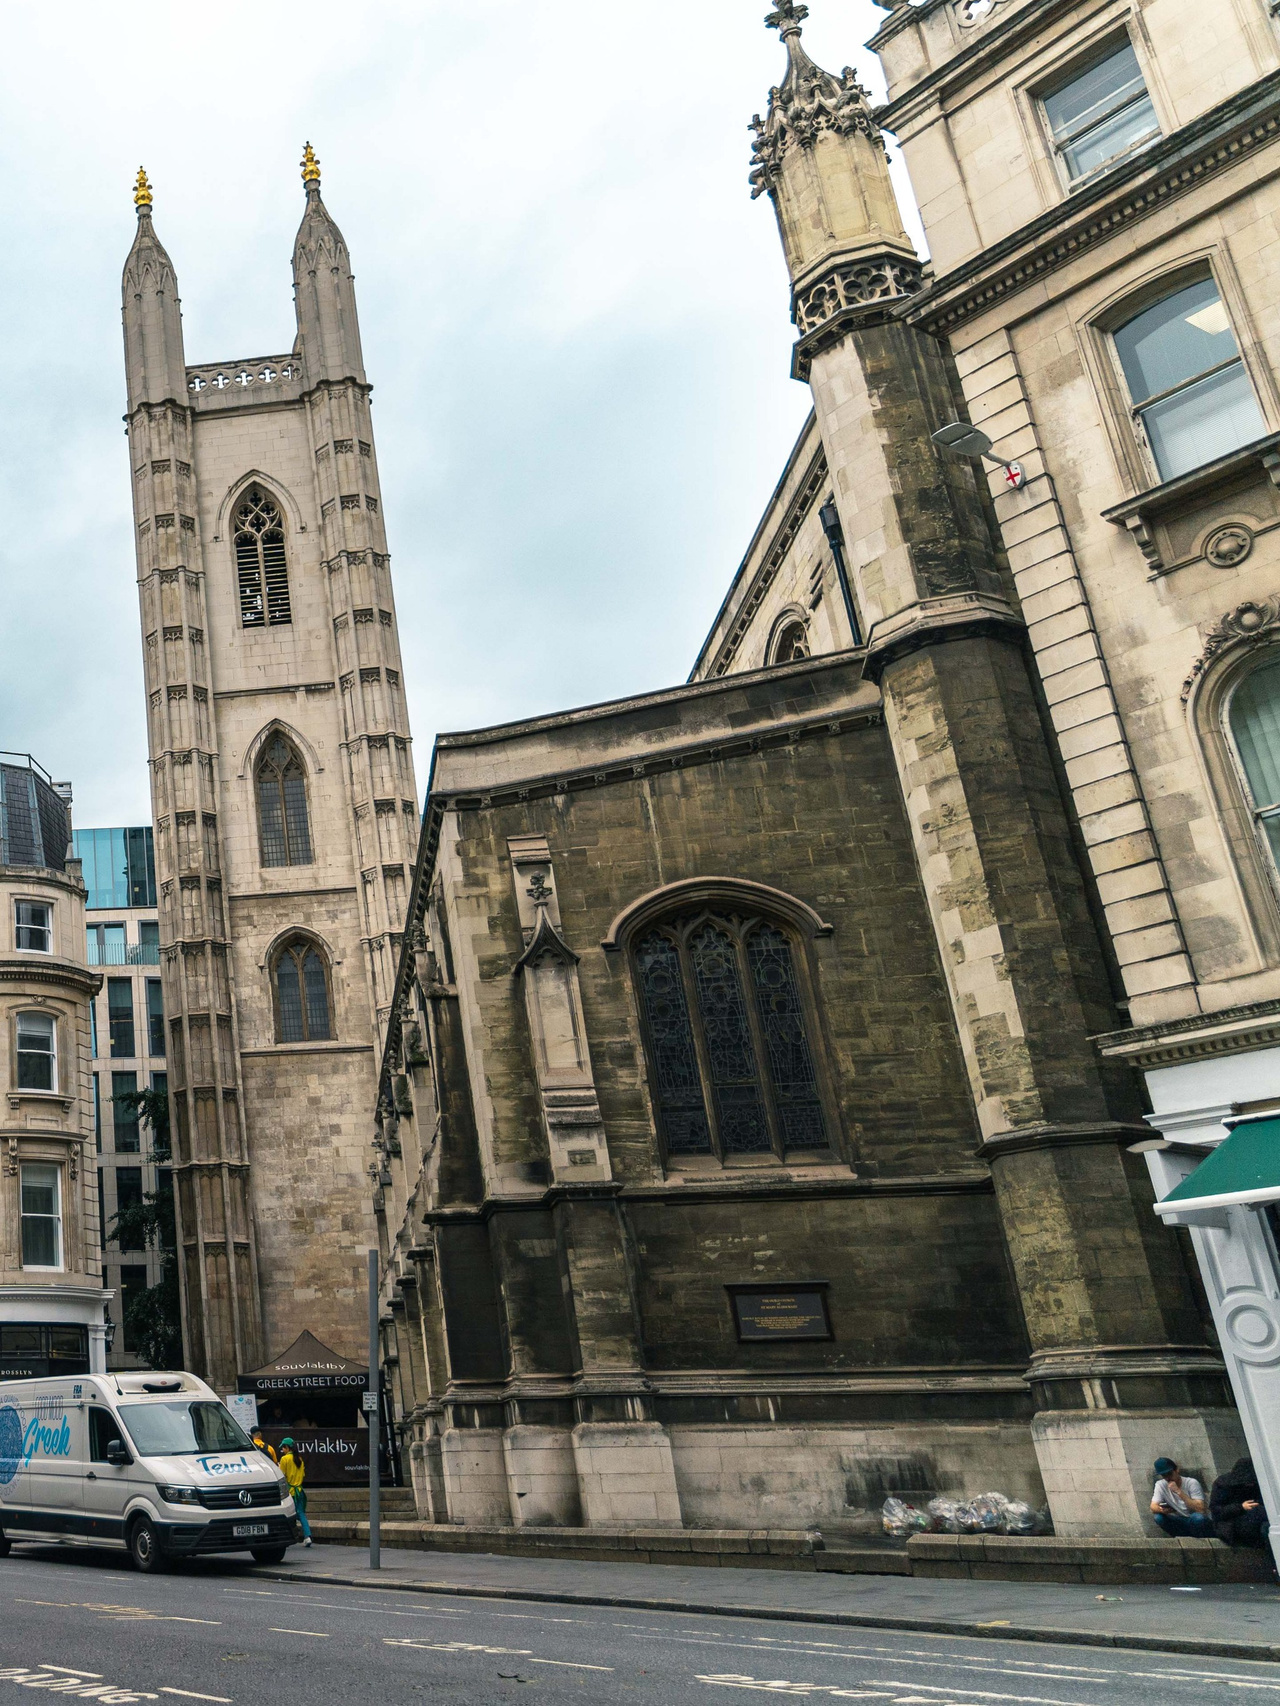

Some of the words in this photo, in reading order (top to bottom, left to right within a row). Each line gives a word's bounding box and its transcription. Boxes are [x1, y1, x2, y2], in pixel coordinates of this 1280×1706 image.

[257, 1379, 292, 1389] GREEK
[293, 1377, 332, 1387] STREET
[335, 1375, 366, 1386] FOOD
[22, 1414, 71, 1468] Greek
[296, 1437, 358, 1456] uvlakiby
[252, 1524, 265, 1534] FBN
